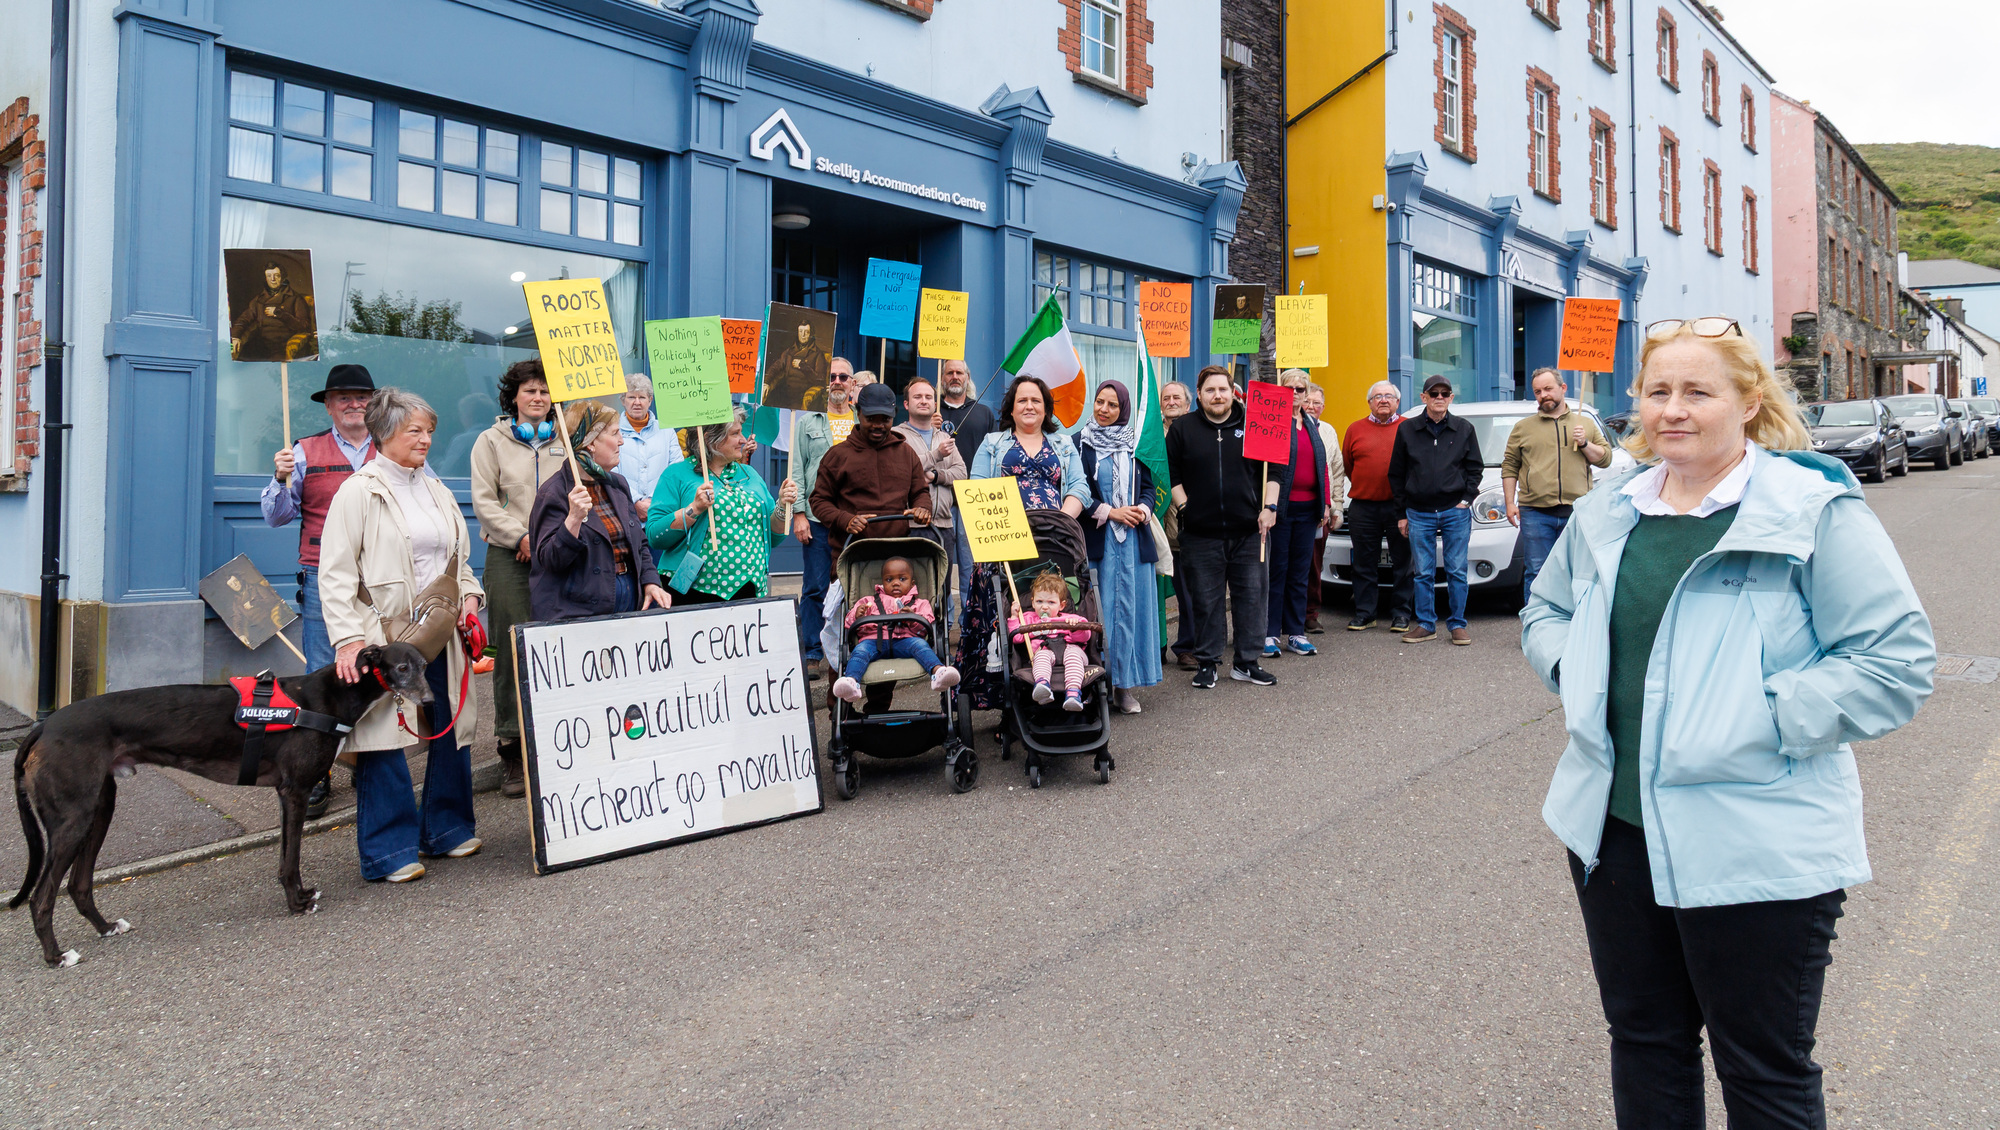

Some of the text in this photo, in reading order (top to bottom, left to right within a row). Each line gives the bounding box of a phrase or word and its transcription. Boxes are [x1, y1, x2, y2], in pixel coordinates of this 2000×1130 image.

[815, 156, 987, 212] Skellig Accommodation Centre
[884, 284, 902, 292] NOT
[1152, 286, 1171, 298] NO
[541, 290, 601, 313] ROOTS
[925, 293, 945, 301] THESE
[936, 303, 951, 312] OUR
[1142, 301, 1188, 315] FORCED
[1280, 298, 1315, 311] LEAVE
[1568, 299, 1588, 314] They
[1604, 304, 1618, 315] here
[922, 313, 966, 324] NEIGHBOURS
[1288, 311, 1311, 325] OUR
[548, 321, 611, 340] MATTER
[703, 326, 711, 337] is
[1145, 319, 1190, 332] REMOVALS
[1564, 322, 1592, 335] Moving
[1229, 328, 1247, 337] NOT
[921, 338, 959, 348] NUMBERS
[1216, 336, 1260, 349] RELOCATE
[1291, 339, 1315, 350] HERE
[1579, 336, 1614, 346] SIMPLY
[558, 343, 618, 368] NORMA
[653, 347, 696, 364] Politically
[701, 345, 720, 361] right
[730, 351, 754, 361] NOT
[1562, 347, 1611, 360] WRONG!
[669, 363, 691, 375] which
[731, 361, 756, 373] them
[564, 364, 615, 392] FOLEY
[658, 375, 702, 390] morally
[1252, 389, 1287, 411] People
[1260, 410, 1283, 422] NOT
[964, 485, 1008, 504] School
[978, 505, 1009, 518] Today
[975, 519, 1011, 531] GONE
[975, 531, 1028, 544] Tomorrow
[581, 645, 627, 683] aon
[635, 621, 673, 675] rud
[690, 608, 769, 664] ceart
[554, 716, 591, 770] go
[746, 668, 800, 716] atá
[676, 771, 705, 828] go
[718, 734, 816, 799] moralta
